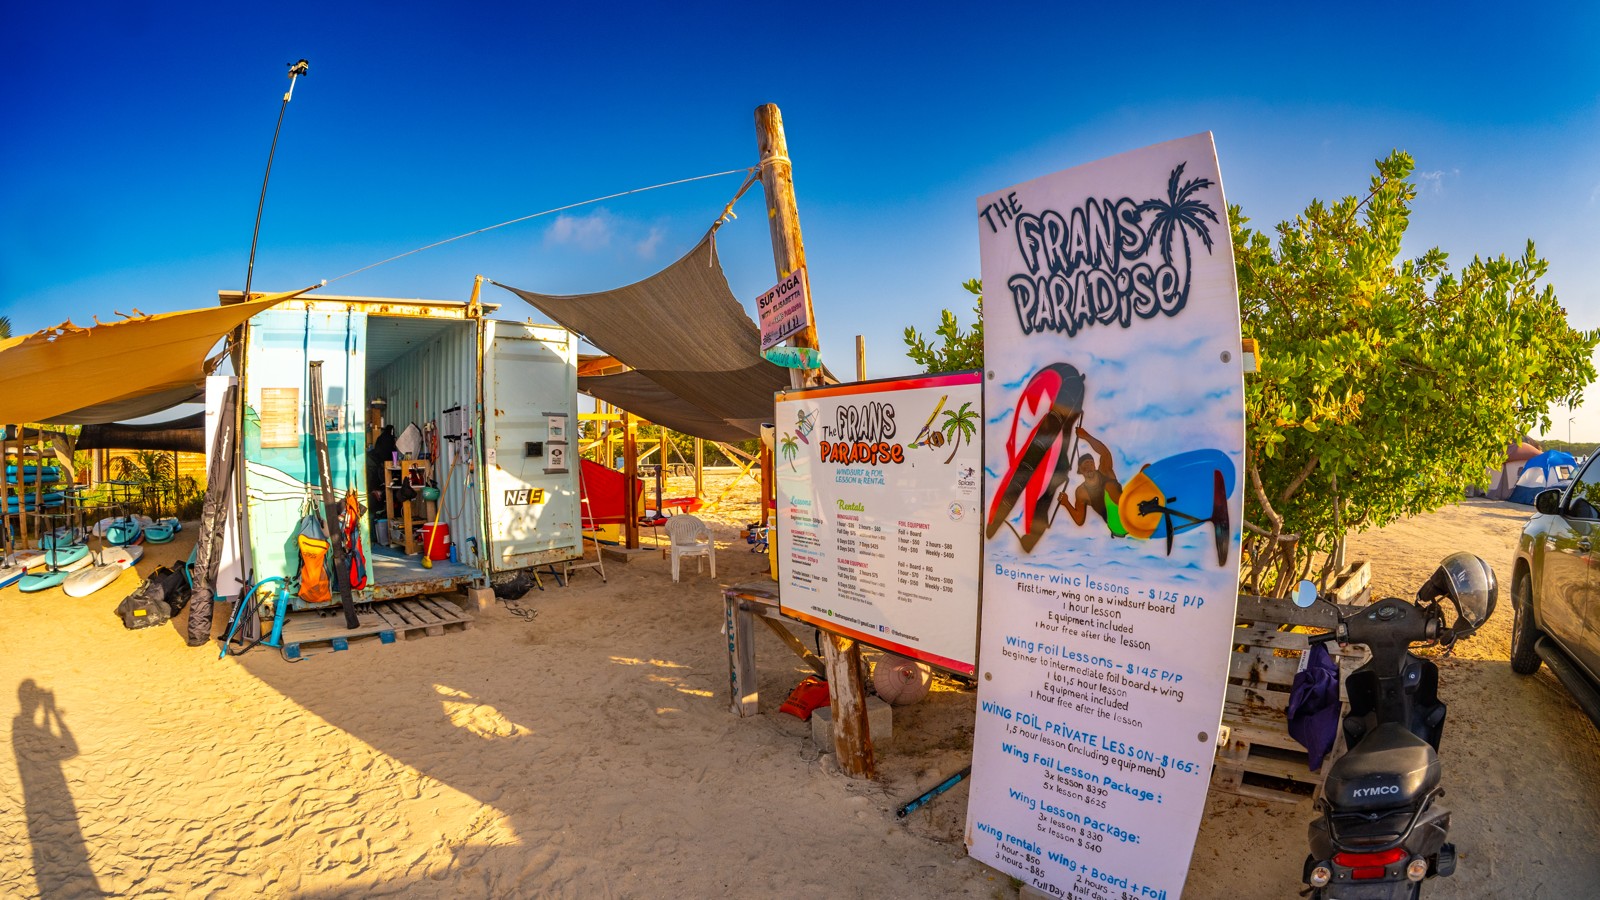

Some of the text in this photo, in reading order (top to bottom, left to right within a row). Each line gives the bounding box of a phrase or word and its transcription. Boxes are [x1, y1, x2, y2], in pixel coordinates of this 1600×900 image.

[980, 191, 1023, 233] THE
[1016, 197, 1147, 277] FRANS
[760, 275, 800, 309] SUP YOGA
[773, 290, 801, 313] ELISABETTA
[822, 401, 896, 443] The FRANS
[836, 468, 865, 476] WINDSURF
[871, 469, 883, 477] FOIL
[863, 477, 885, 485] RENTAL
[836, 499, 865, 512] Rentals
[907, 521, 930, 530] EQUIPMENT
[925, 549, 940, 558] Weekly
[925, 582, 940, 591] Weekly
[995, 564, 1045, 581] Beginner
[1086, 575, 1129, 595] lessons
[1149, 588, 1178, 603] $125
[1017, 582, 1036, 593] First
[1061, 591, 1081, 603] wing
[1084, 594, 1095, 602] on
[1097, 596, 1103, 604] a
[1147, 598, 1176, 614] board
[1048, 611, 1134, 634] Equipment included
[1068, 602, 1089, 614] hour
[1091, 602, 1122, 619] lesson
[1039, 621, 1059, 632] hour
[1062, 624, 1078, 637] free
[1080, 629, 1101, 642] after
[1103, 632, 1117, 644] the
[1120, 634, 1152, 651] lesson
[1002, 646, 1038, 664] beginner
[1040, 656, 1049, 667] to
[1050, 658, 1105, 680] intermediate
[1106, 671, 1121, 684] foil
[1121, 675, 1151, 692] board
[1037, 641, 1059, 657] Foil
[1062, 646, 1114, 669] Lessons
[1126, 663, 1159, 679] $145
[1044, 682, 1129, 711] Equipment included
[1053, 672, 1062, 683] to
[1077, 678, 1098, 692] hour
[1099, 682, 1128, 698] lesson
[1036, 691, 1055, 705] hour
[1057, 696, 1073, 709] free
[1075, 701, 1095, 715] after
[1097, 706, 1111, 720] the
[1113, 712, 1143, 729] lesson
[1019, 727, 1039, 742] hour
[1039, 733, 1067, 751] lesson
[1068, 742, 1110, 766] (including
[1111, 757, 1166, 779] equipment)
[1033, 752, 1054, 769] Foil
[1056, 762, 1100, 784] Lesson
[1042, 781, 1108, 810] 5x lesson $625
[1044, 769, 1109, 798] 3x lesson $390
[1353, 785, 1400, 798] KYMCO
[1038, 812, 1048, 823] 3x
[1049, 817, 1077, 834] lesson
[1040, 799, 1081, 825] Lesson
[1006, 833, 1043, 856] rentals
[1037, 823, 1047, 834] 5x
[1048, 826, 1075, 845] lesson
[995, 851, 1000, 859] 3
[1001, 854, 1024, 870] hours
[1001, 842, 1020, 857] hour
[1032, 878, 1066, 899] Full Day
[1073, 882, 1091, 897] half
[1076, 874, 1083, 883] 2
[1084, 877, 1108, 895] hours
[1080, 863, 1089, 875] +
[1091, 867, 1128, 889] Board
[1130, 883, 1140, 893] +
[1141, 885, 1167, 900] Foil
